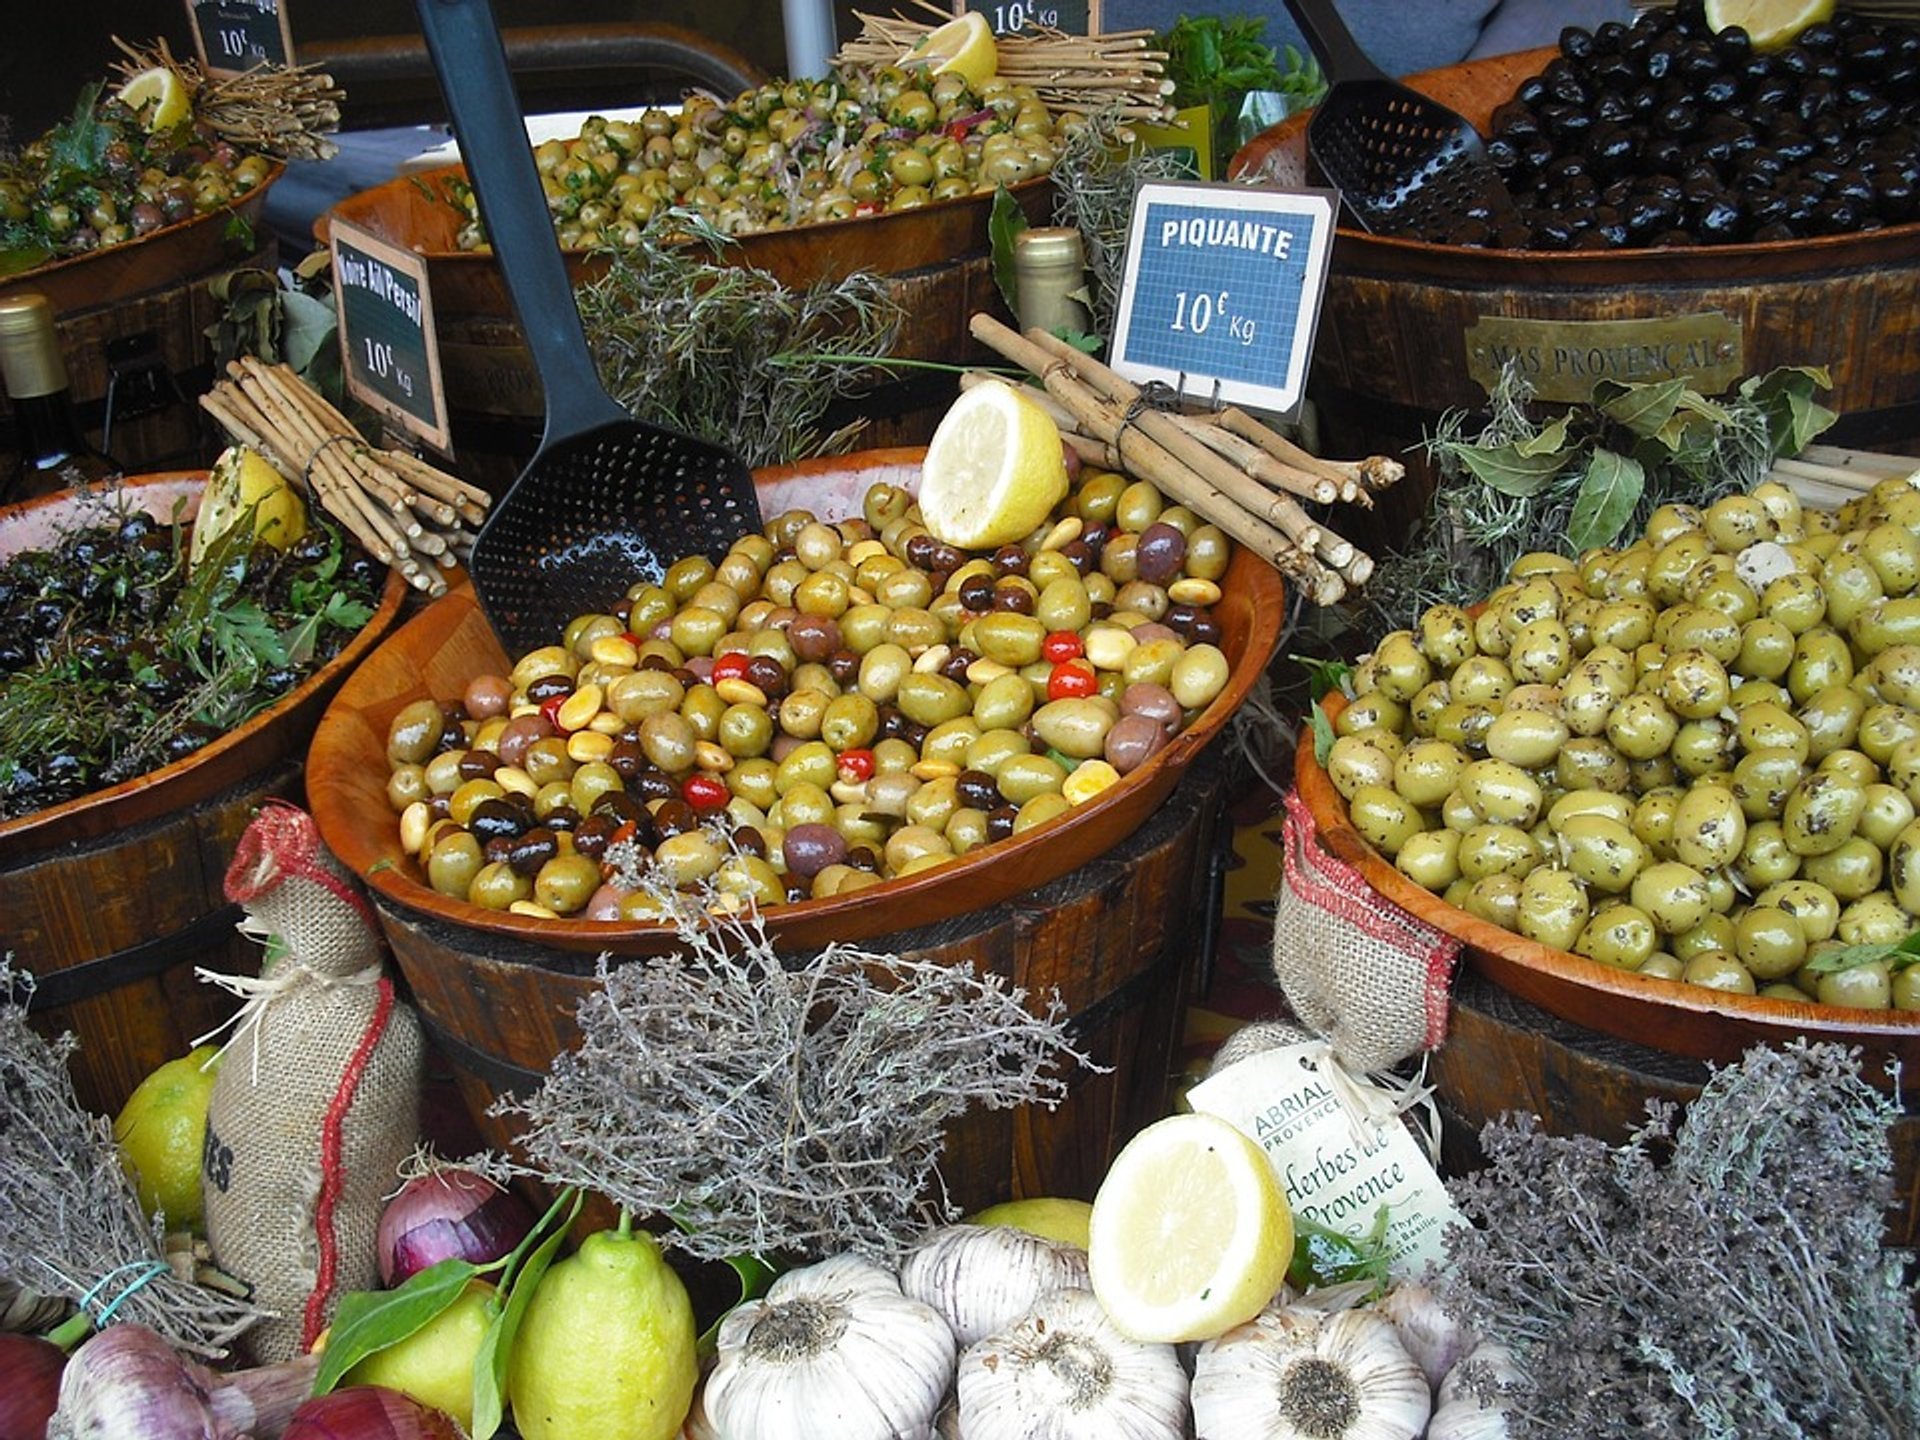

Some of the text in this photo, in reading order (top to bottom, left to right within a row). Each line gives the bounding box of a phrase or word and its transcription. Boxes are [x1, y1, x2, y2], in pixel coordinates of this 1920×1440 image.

[1161, 218, 1294, 260] PIQUANTE
[1489, 339, 1719, 378] MAS PROVENÇAL
[1256, 1081, 1335, 1136] ABRIAL
[1300, 1161, 1405, 1225] Provence
